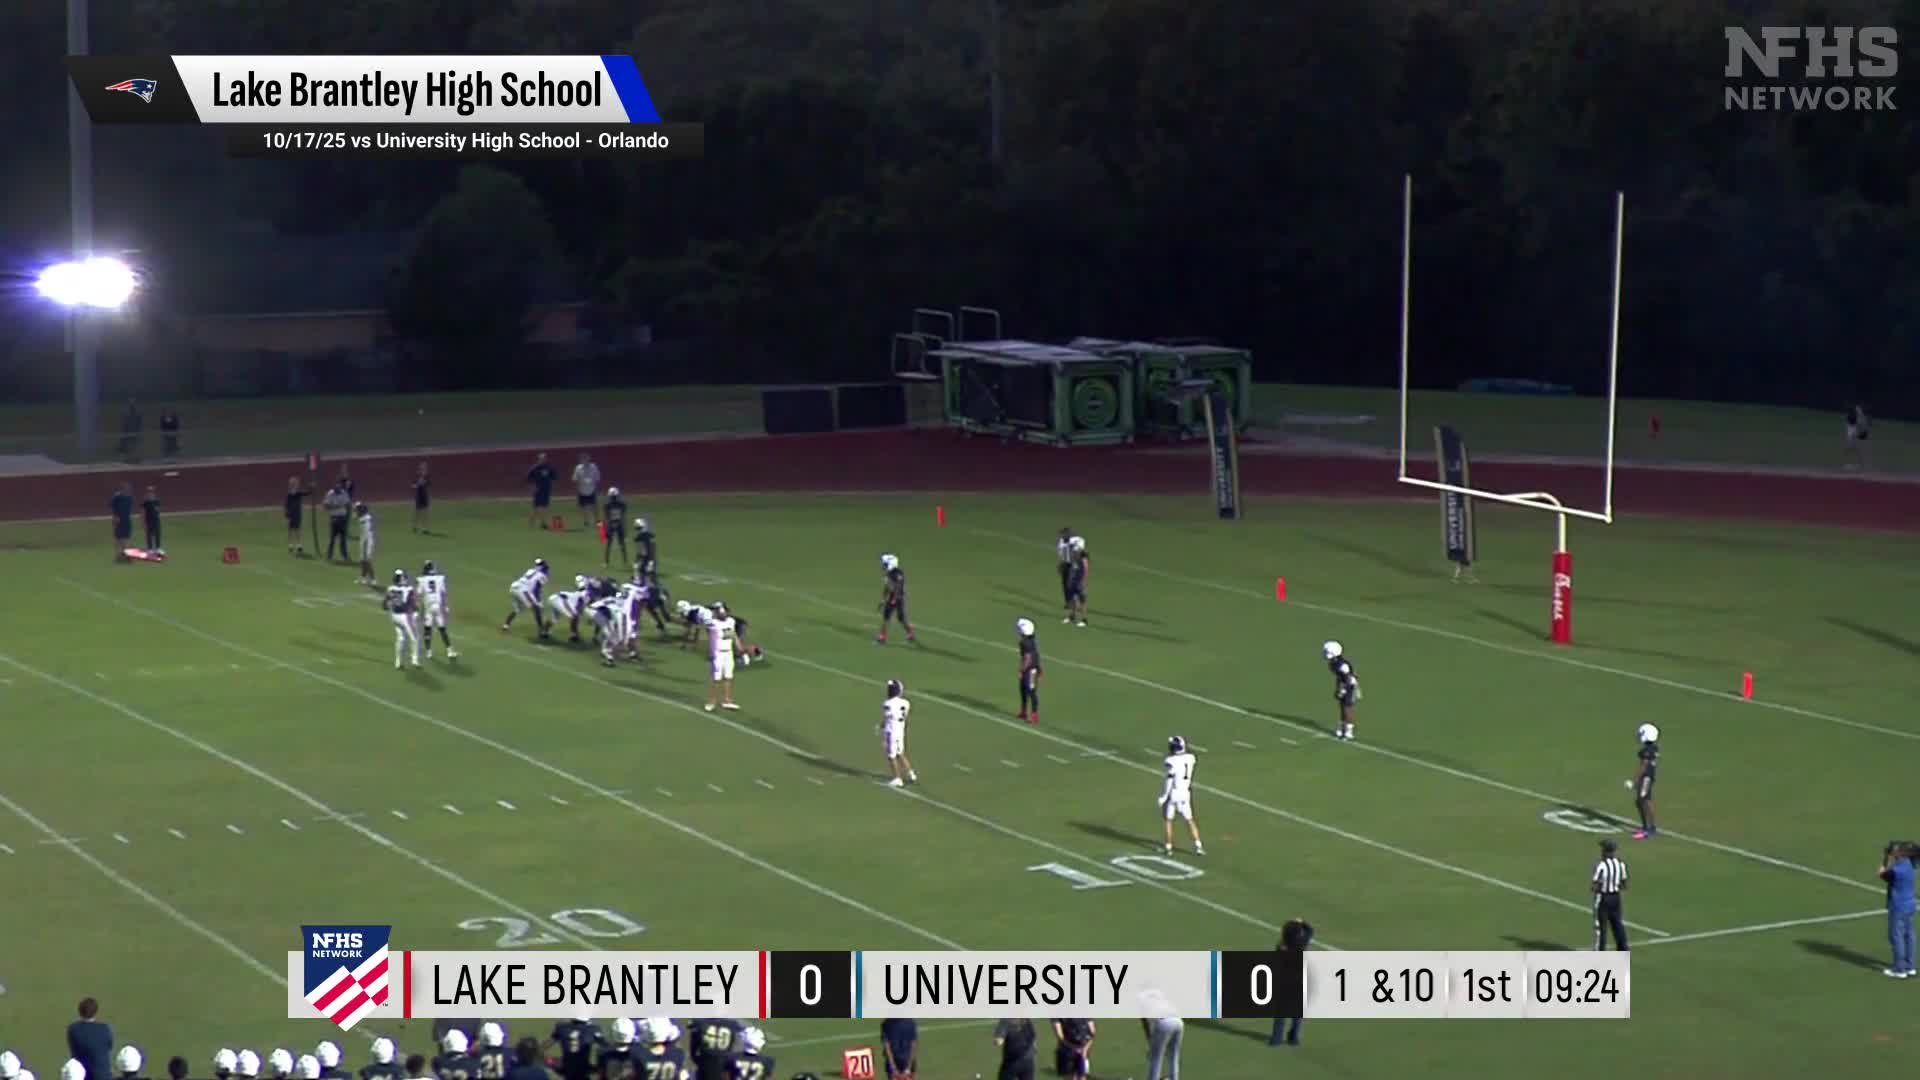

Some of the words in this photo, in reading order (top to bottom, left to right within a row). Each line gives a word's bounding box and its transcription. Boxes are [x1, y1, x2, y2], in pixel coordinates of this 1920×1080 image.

[1182, 763, 1189, 780] 1
[1025, 855, 1205, 889] 10
[457, 908, 647, 948] 20
[481, 1054, 504, 1078] 21
[849, 1055, 870, 1077] 20
